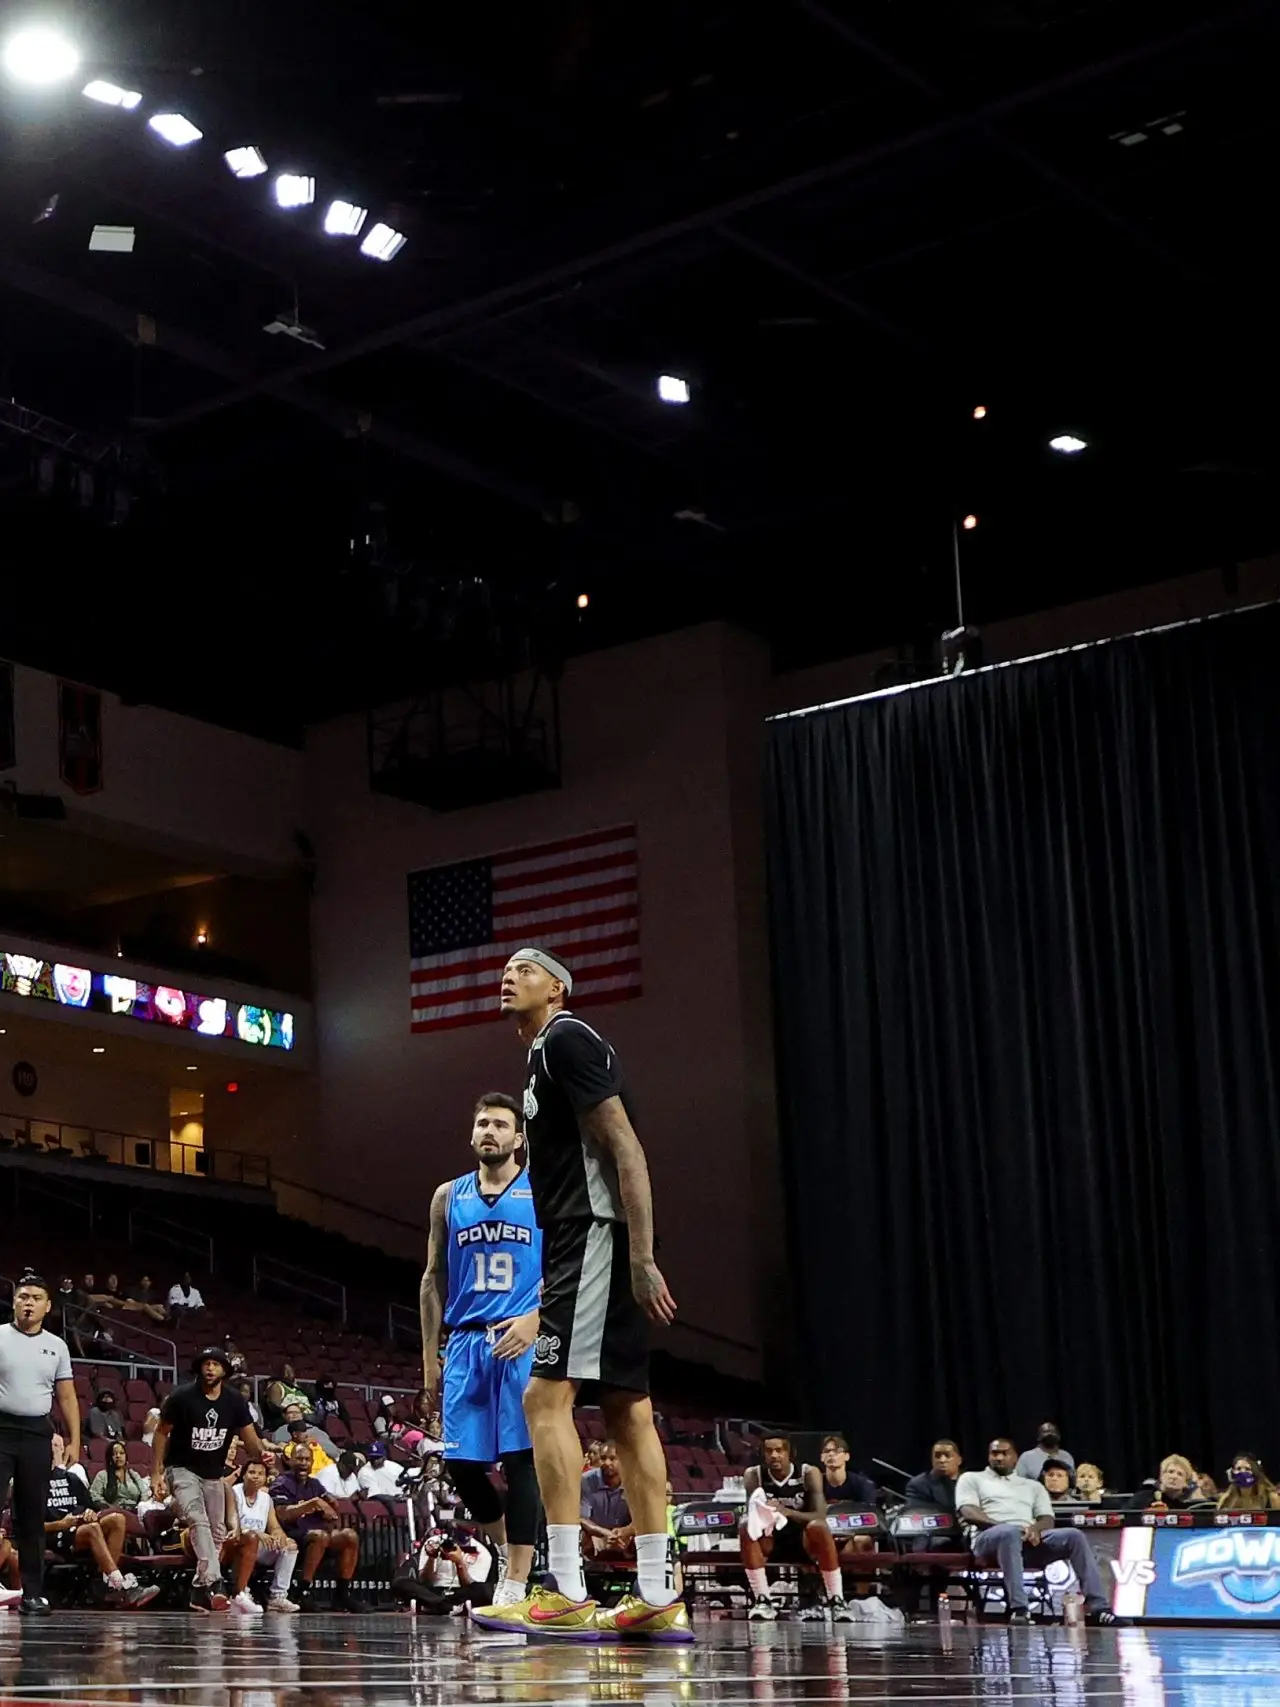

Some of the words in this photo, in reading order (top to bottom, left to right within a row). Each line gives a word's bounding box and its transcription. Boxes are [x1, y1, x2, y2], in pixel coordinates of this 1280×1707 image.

[457, 1222, 530, 1247] POWER
[474, 1252, 513, 1292] 19
[192, 1427, 227, 1441] MPLS
[1180, 1532, 1280, 1571] POW
[1110, 1560, 1156, 1585] VS
